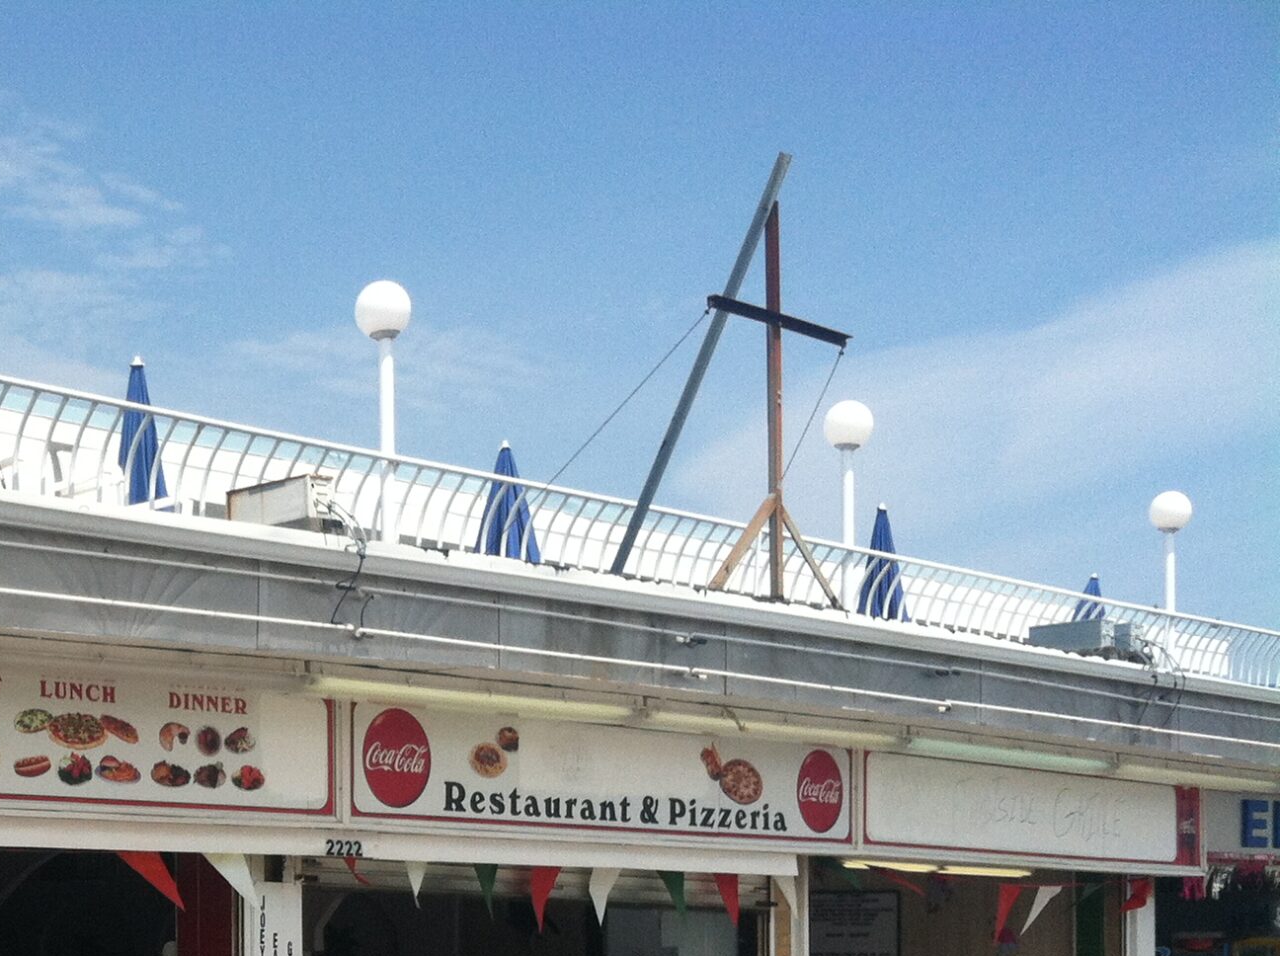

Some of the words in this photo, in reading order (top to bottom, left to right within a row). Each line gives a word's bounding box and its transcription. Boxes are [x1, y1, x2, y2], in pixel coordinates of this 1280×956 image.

[39, 680, 116, 704] LUNCH
[168, 691, 249, 715] DINNER
[443, 781, 632, 824] Restaurant
[639, 797, 660, 824] &
[668, 797, 788, 832] Pizzeria
[1240, 798, 1280, 850] E
[325, 839, 363, 857] 2222
